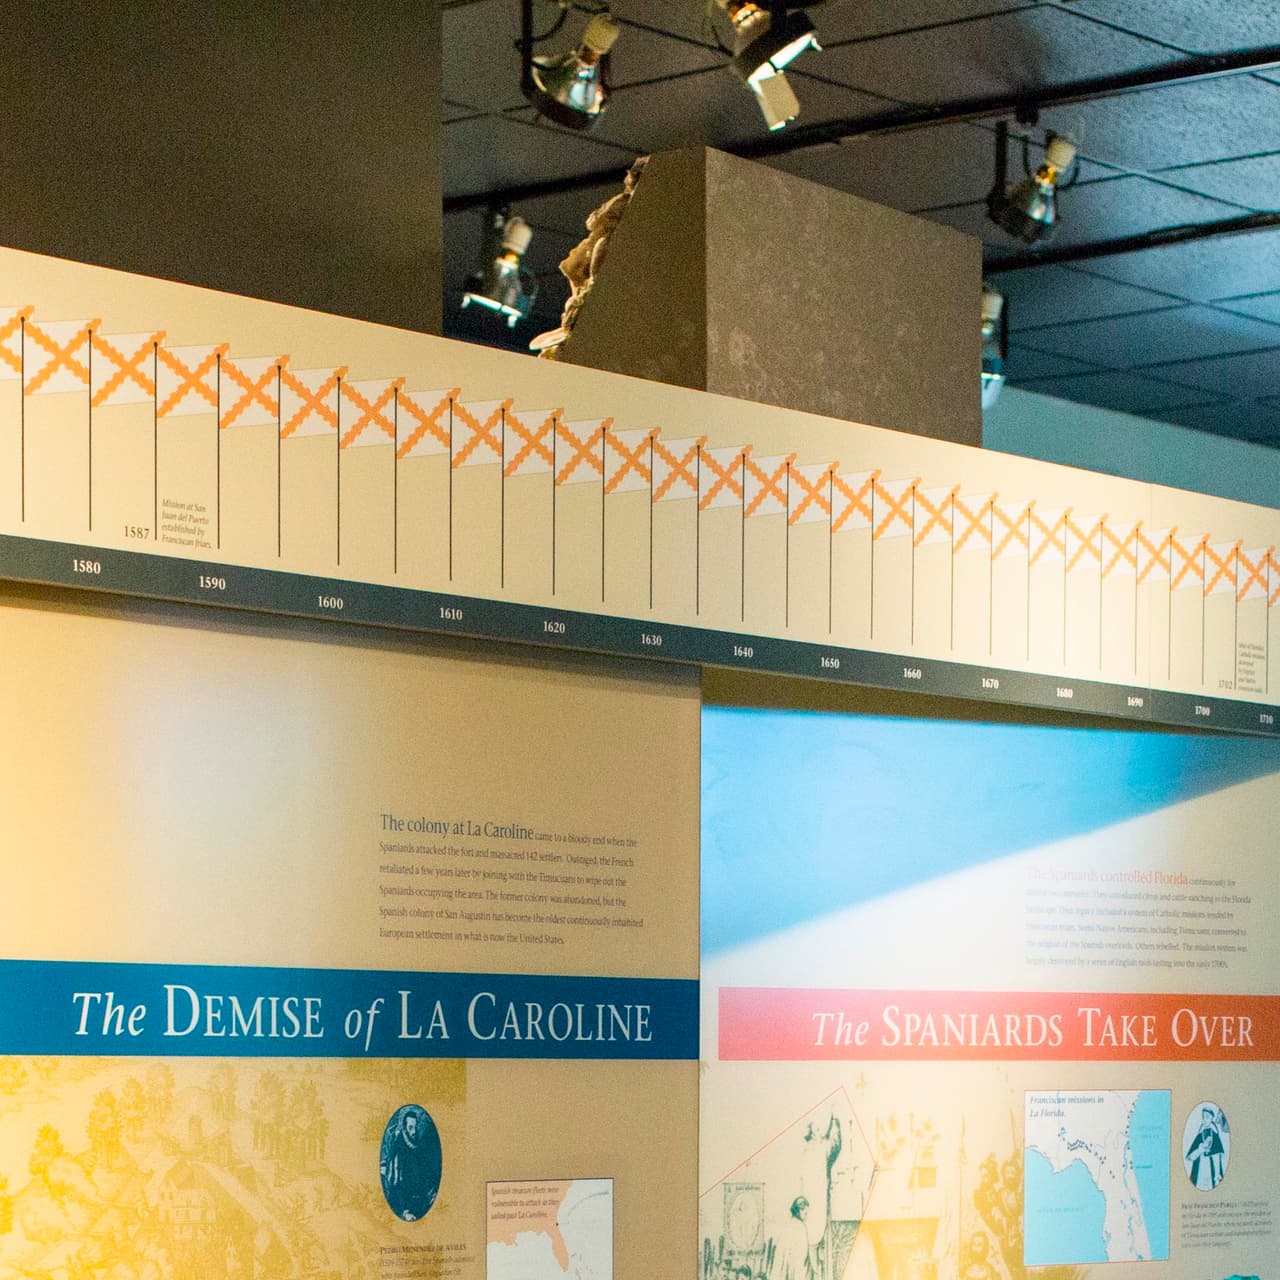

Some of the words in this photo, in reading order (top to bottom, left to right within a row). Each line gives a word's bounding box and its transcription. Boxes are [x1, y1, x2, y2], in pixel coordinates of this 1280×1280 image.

[124, 525, 149, 540] 1587
[72, 558, 101, 575] 1580
[199, 575, 226, 591] 1590
[318, 596, 343, 610] 1600
[439, 607, 462, 621] 1610
[543, 620, 565, 634] 1620
[641, 632, 662, 646] 1630
[733, 645, 753, 658] 1640
[820, 656, 840, 670] 1650
[903, 667, 921, 680] 1660
[981, 677, 999, 690] 1670
[1056, 687, 1073, 699] 1680
[1127, 696, 1143, 709] 1690
[379, 815, 404, 831] The
[406, 818, 449, 839] colony
[452, 820, 465, 836] at
[467, 821, 482, 837] La
[483, 822, 534, 840] Caroline
[1154, 872, 1188, 884] Florida
[72, 992, 147, 1036] The
[163, 984, 324, 1039] DEMISE
[344, 996, 384, 1051] of
[398, 990, 450, 1040] LA
[468, 992, 653, 1043] CAROLINE
[812, 1012, 869, 1047] The
[881, 1006, 1063, 1047] SPANIARDS
[1078, 1007, 1158, 1047] TAKE
[1171, 1008, 1254, 1048] OVER
